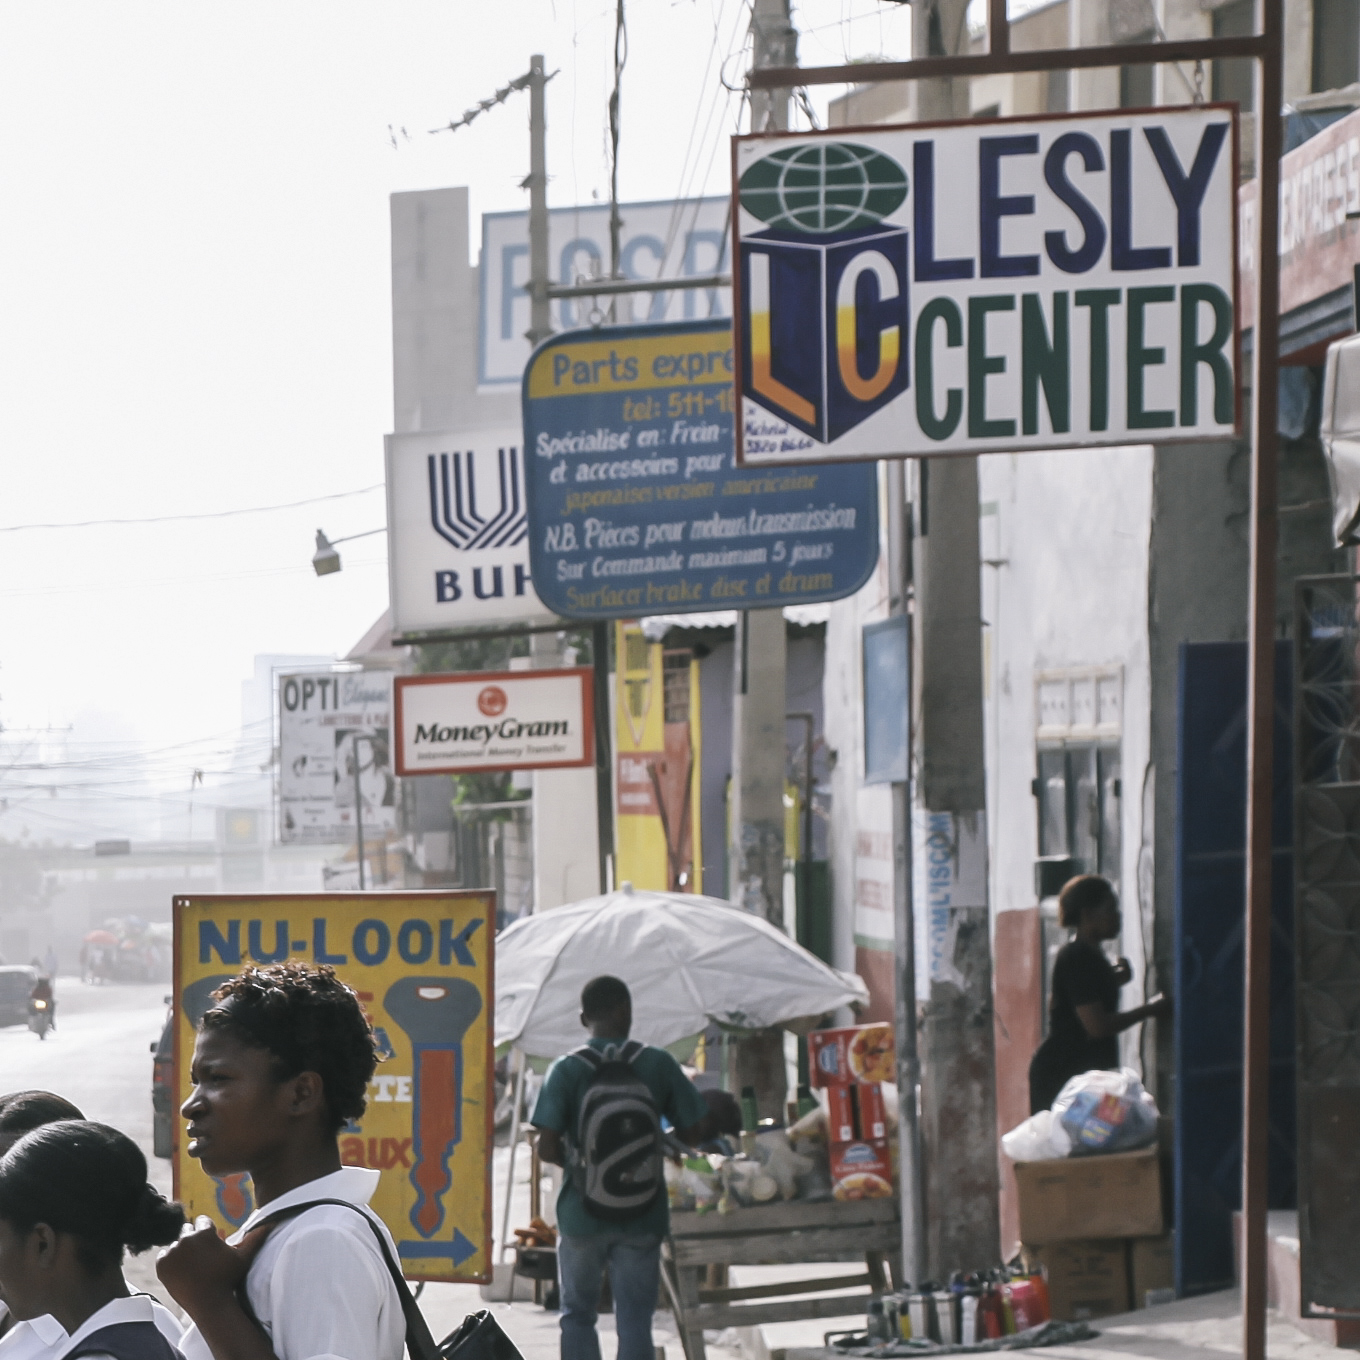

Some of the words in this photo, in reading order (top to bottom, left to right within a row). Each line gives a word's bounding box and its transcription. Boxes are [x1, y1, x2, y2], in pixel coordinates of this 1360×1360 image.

[913, 122, 1231, 283] LESLY
[554, 351, 640, 387] Parts
[914, 282, 1235, 442] CENTER
[684, 452, 727, 480] pour
[644, 519, 687, 550] pour
[556, 558, 587, 582] Sur
[771, 540, 787, 562] 5
[284, 677, 339, 712] OPTI
[414, 717, 570, 746] MoneyGram
[199, 918, 484, 967] NU-LOOK
